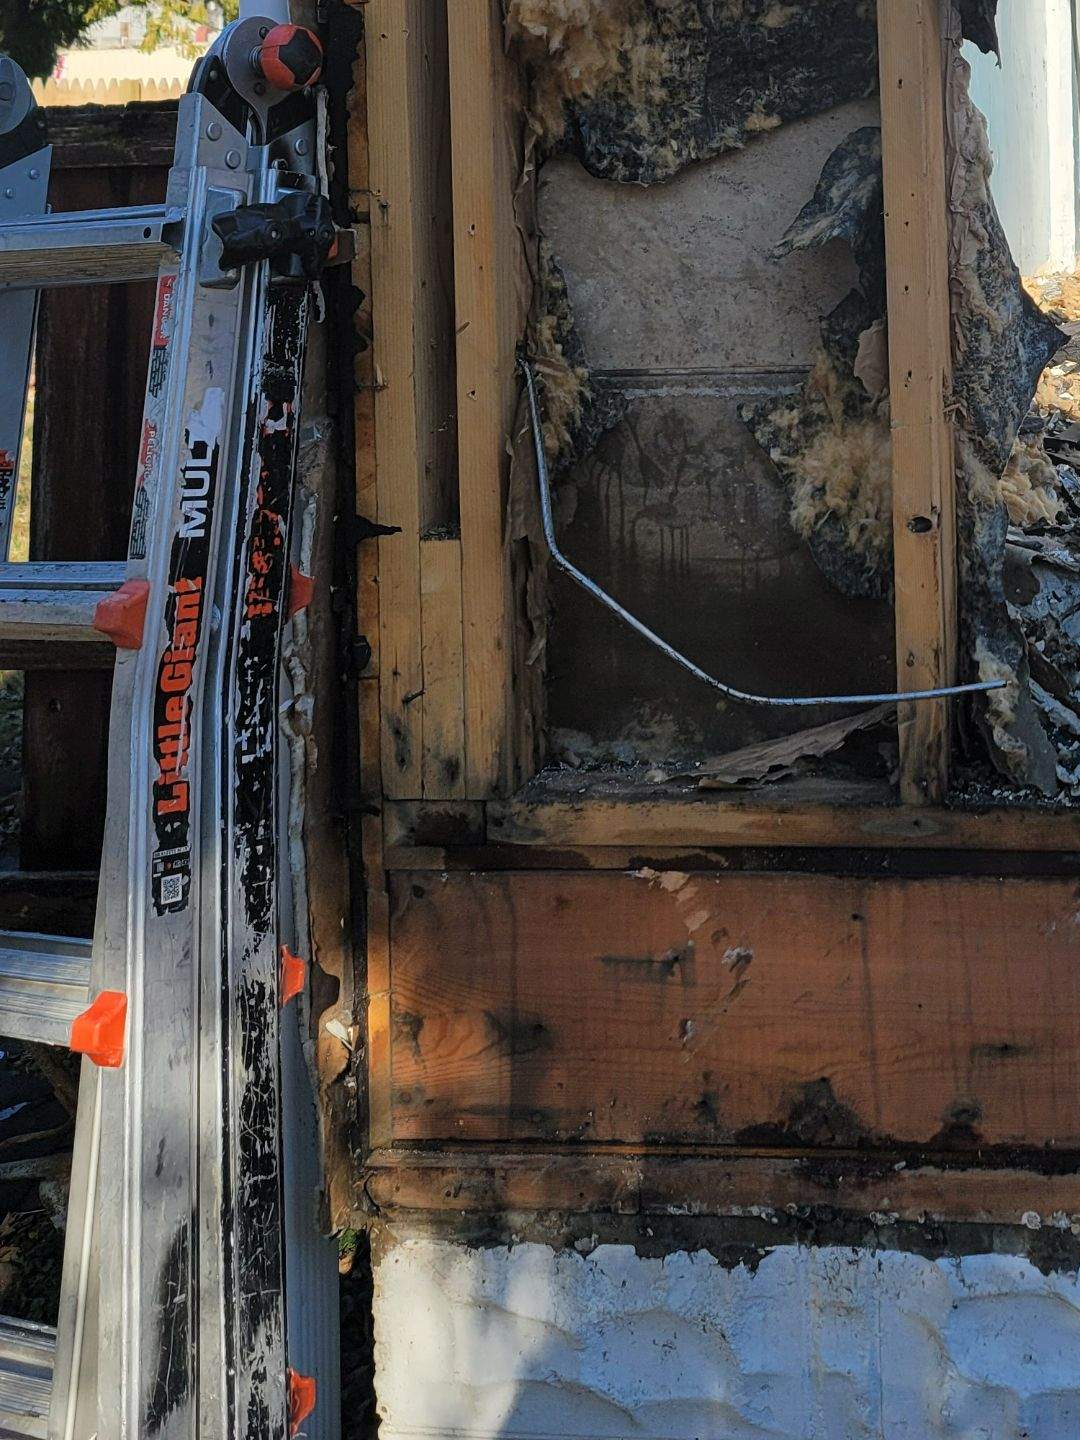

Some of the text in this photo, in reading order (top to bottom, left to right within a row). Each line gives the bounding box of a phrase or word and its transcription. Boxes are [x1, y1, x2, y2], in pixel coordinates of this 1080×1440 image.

[178, 430, 213, 539] MUL
[160, 576, 203, 691] Giant
[157, 692, 189, 815] Little
